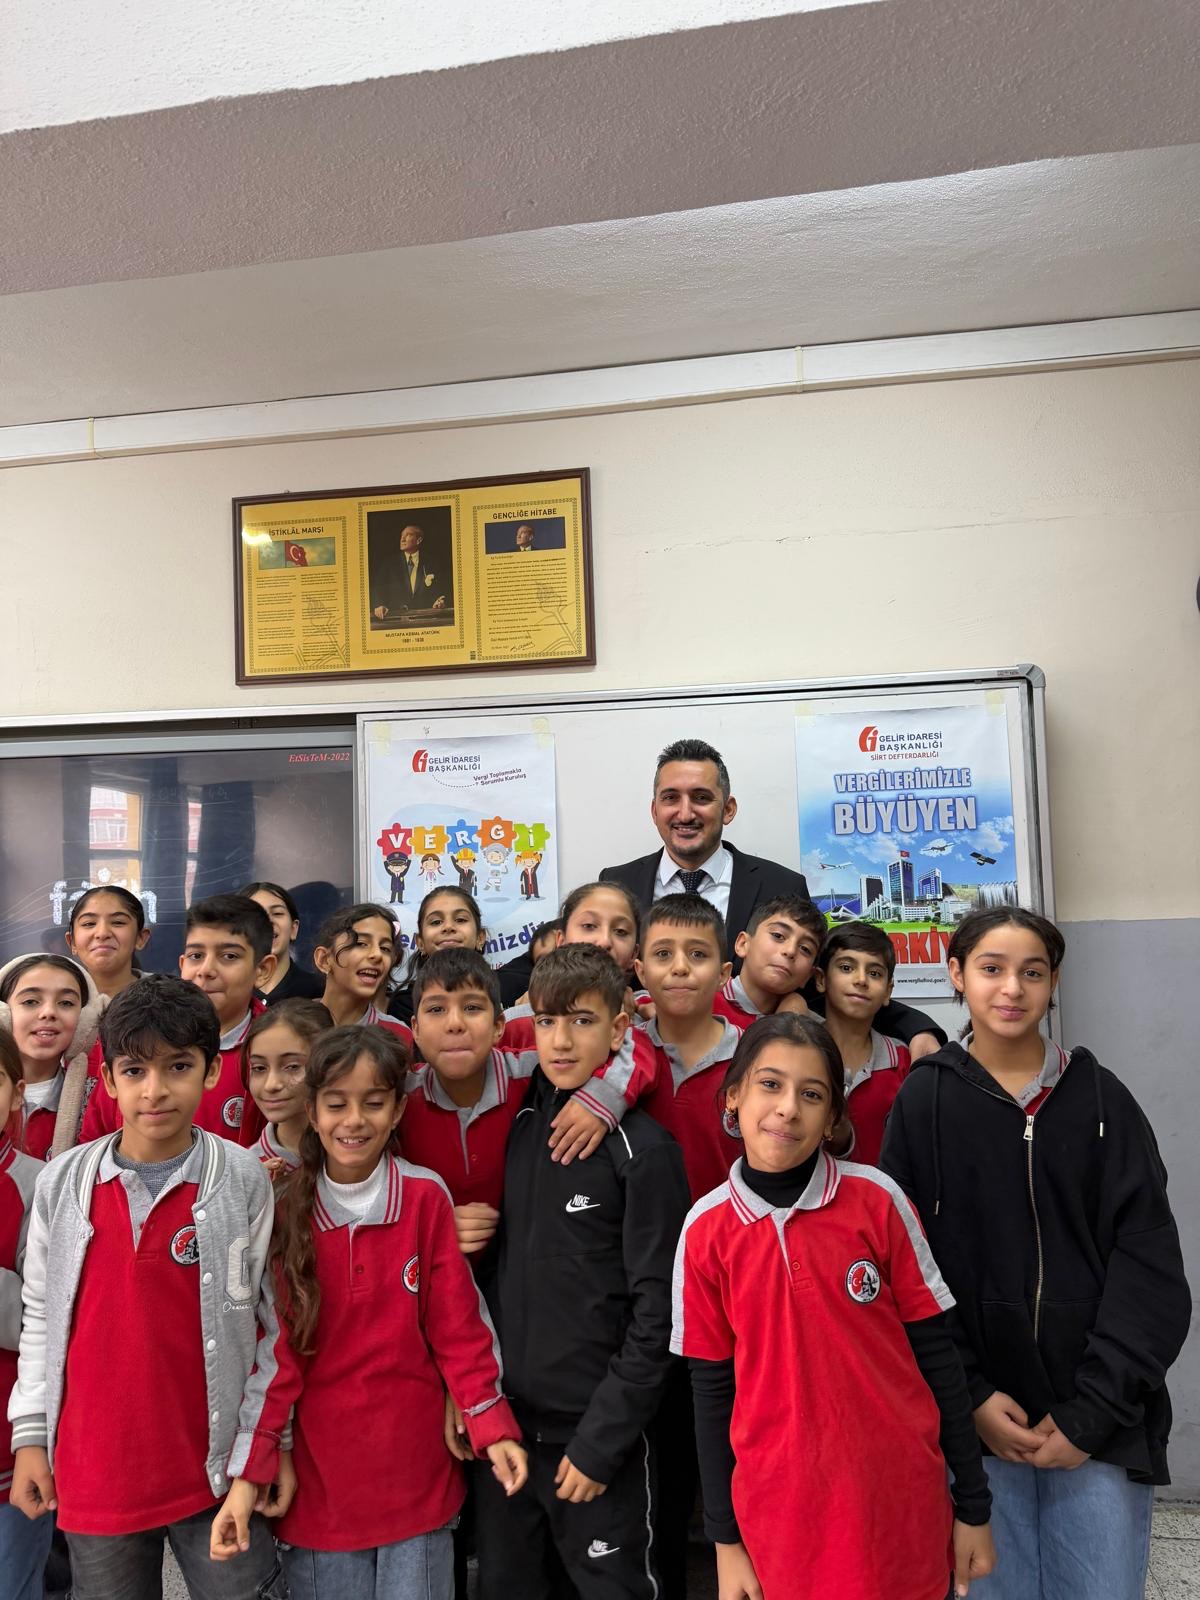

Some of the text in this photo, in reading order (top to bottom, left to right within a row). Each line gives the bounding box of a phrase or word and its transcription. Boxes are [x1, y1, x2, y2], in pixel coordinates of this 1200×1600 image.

[492, 508, 557, 520] GENÇLİĞE HİTABE
[301, 526, 324, 534] MARŞI
[879, 731, 942, 743] GELİR İDARESİ
[879, 741, 943, 752] BAŞKANLIĞI
[428, 755, 481, 765] GELİR İDARESİ
[888, 751, 939, 760] DEFTERDARLIĞI
[428, 763, 481, 772] BAŞKANLIĞI
[489, 768, 522, 779] Toplamakla
[480, 773, 527, 786] Sorumlu Kuruluş
[834, 766, 971, 793] VERGİLERİMİZLE
[834, 794, 977, 835] BÜYÜYEN
[571, 1194, 591, 1207] NIKE
